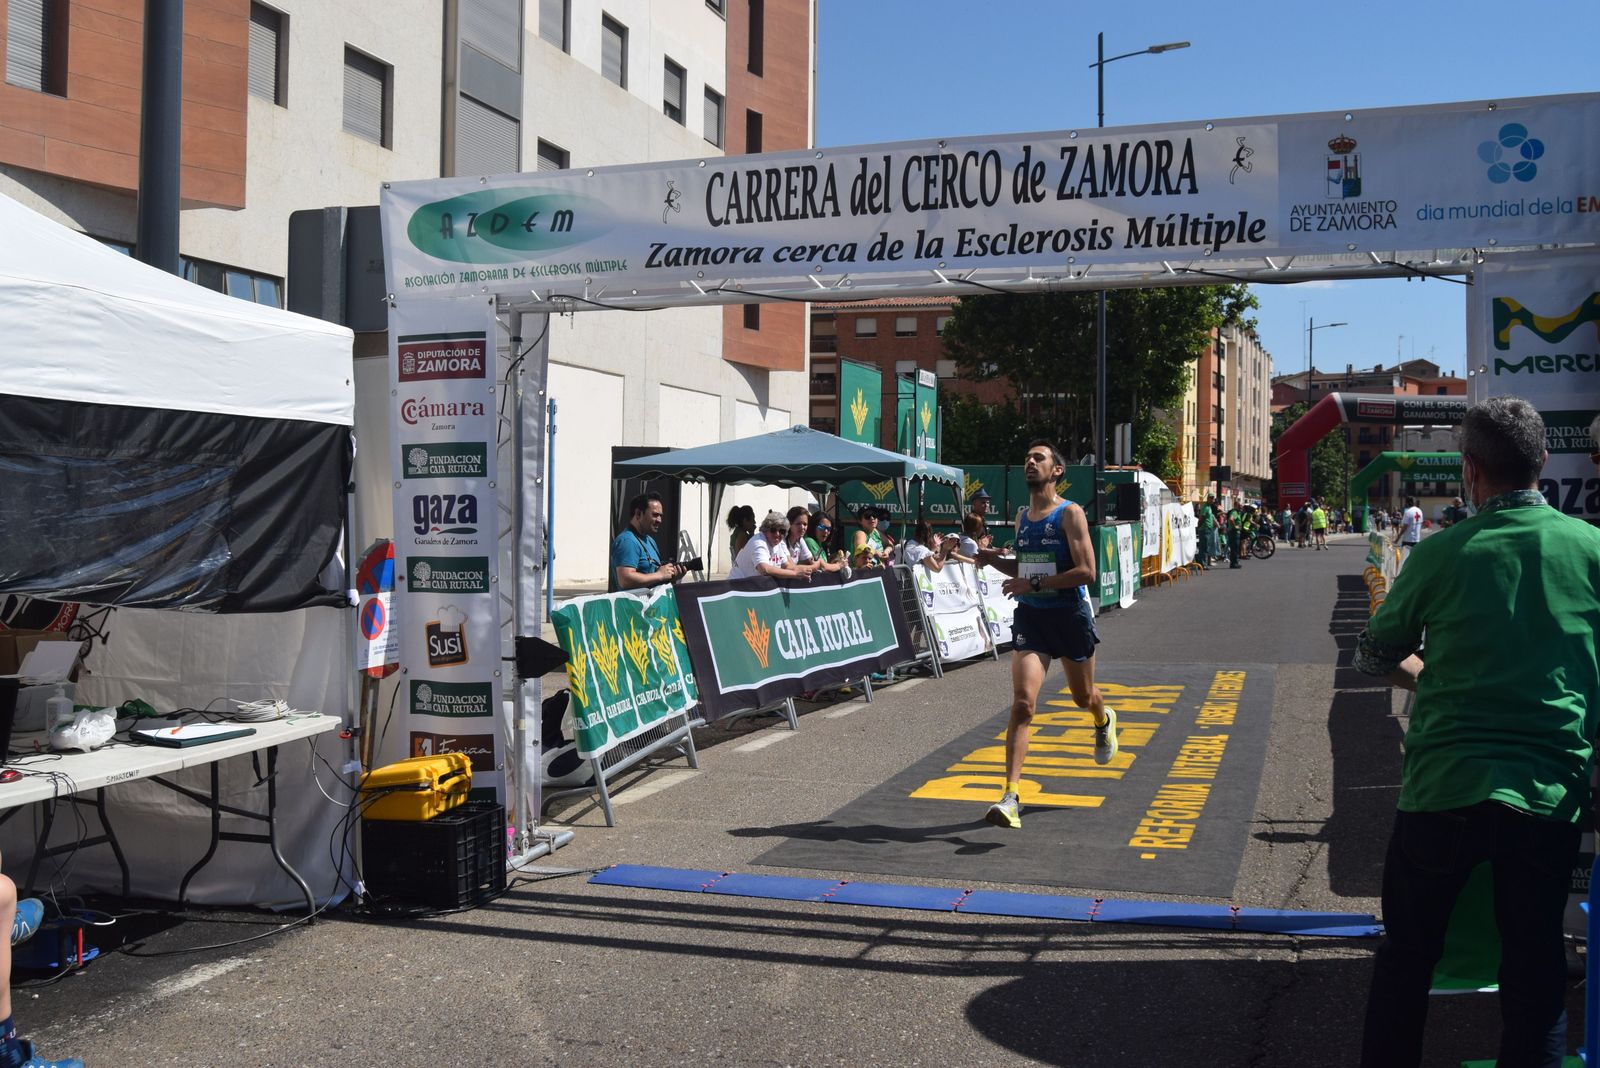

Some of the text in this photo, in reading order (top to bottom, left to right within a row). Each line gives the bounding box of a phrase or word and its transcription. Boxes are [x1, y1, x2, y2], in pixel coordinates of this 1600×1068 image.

[705, 137, 1199, 227] CARRERA del CERCO de ZAMORA
[1290, 200, 1398, 216] AYUNTAMIENTO
[1416, 203, 1444, 221] dia
[1449, 199, 1524, 219] mundial
[1290, 213, 1397, 232] DE ZAMORA
[645, 211, 1267, 269] Zamora cerca de la Esclerosis Múltiple
[404, 257, 628, 288] ASOCIACIÓN ZAMORANA DE ESCLEROSIS MÚLTIPLE
[417, 348, 481, 359] DIPUTACIÓN DE
[416, 358, 481, 374] ZAMORA
[1403, 400, 1467, 409] CON EL DEPOR
[401, 397, 485, 425] Cámara
[1402, 411, 1466, 419] GANAMOS TOD
[431, 423, 456, 431] Zamora
[1544, 426, 1592, 437] UNDAC
[1545, 437, 1567, 448] AJA
[429, 455, 481, 464] FUNDACION
[430, 464, 482, 474] CAJA RURAL
[1539, 478, 1600, 514] aza
[412, 494, 478, 535] gaza
[930, 503, 999, 515] CAJA RUAL
[450, 537, 478, 546] Zamora
[431, 570, 483, 580] FUNDACION
[431, 580, 484, 589] CAJA RURAL
[774, 609, 874, 660] CAJA RURAL
[429, 632, 462, 656] Susi
[432, 693, 487, 704] FUNDACION
[432, 703, 487, 713] CAJA RURAL
[1128, 734, 1230, 849] REFORMA INTEGRAL
